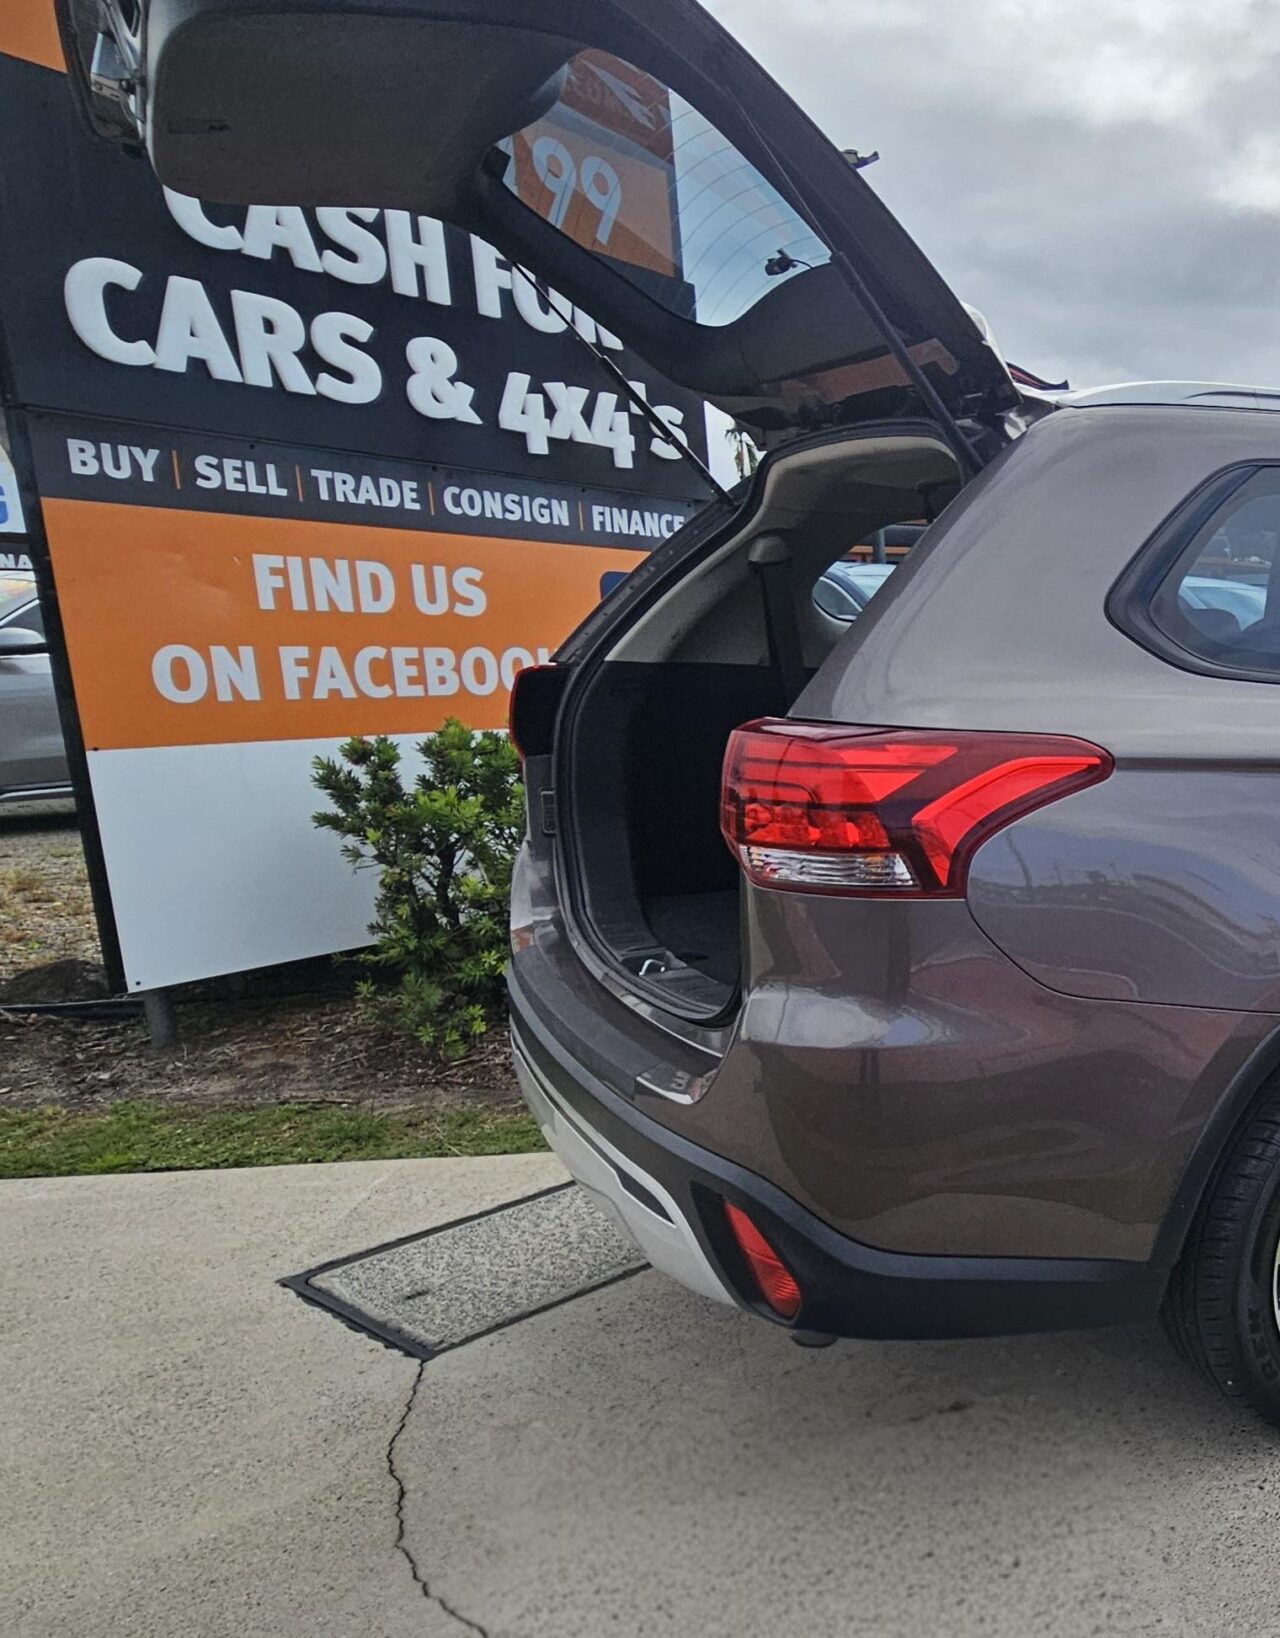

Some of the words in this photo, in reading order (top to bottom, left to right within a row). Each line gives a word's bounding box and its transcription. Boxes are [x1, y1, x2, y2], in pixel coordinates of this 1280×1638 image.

[64, 256, 383, 404] CARS
[405, 336, 483, 425] &
[66, 438, 160, 482] BUY
[194, 455, 288, 497] SELL
[310, 468, 421, 511] TRADE
[443, 486, 570, 526] CONSIGN
[252, 553, 395, 614] FIND
[410, 563, 487, 617] US
[151, 643, 261, 704] ON
